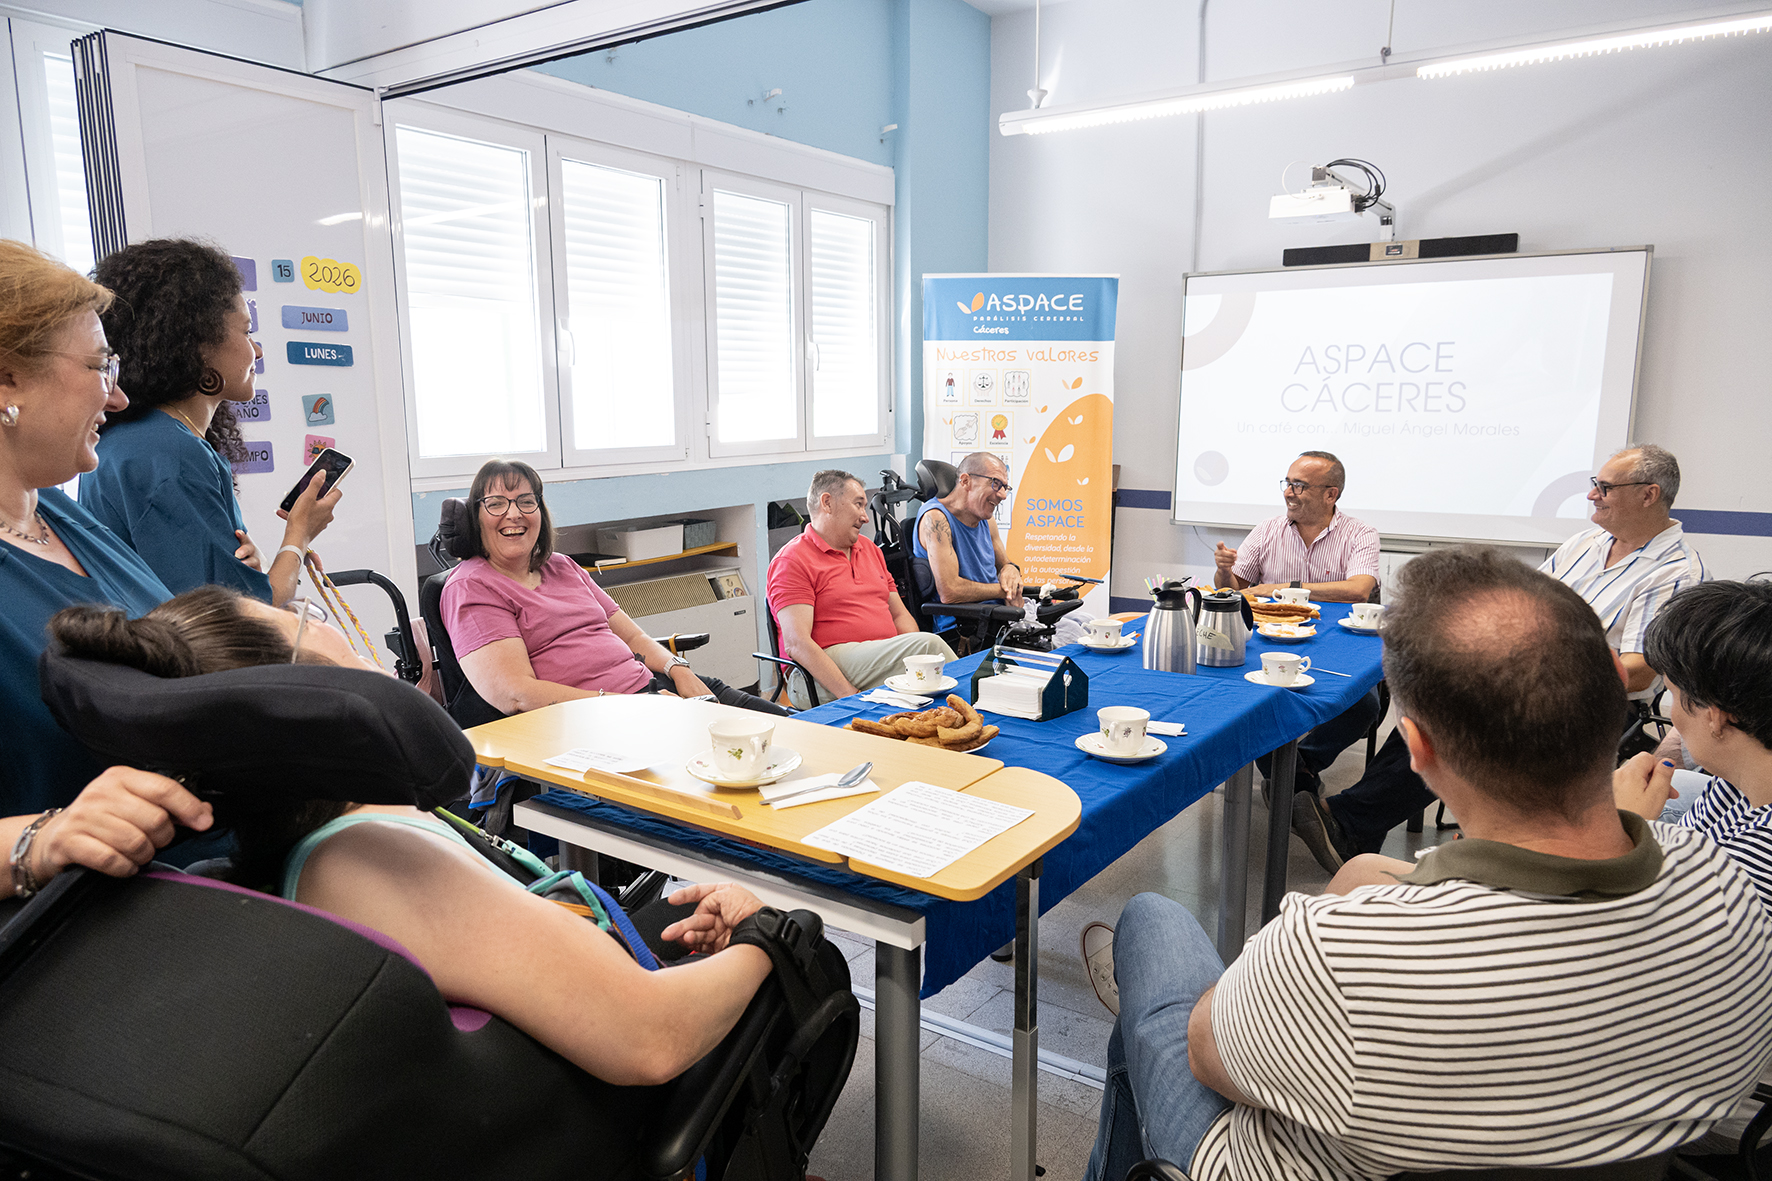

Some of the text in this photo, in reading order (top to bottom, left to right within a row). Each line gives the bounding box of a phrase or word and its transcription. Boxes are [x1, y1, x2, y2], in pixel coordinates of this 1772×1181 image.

[277, 264, 291, 278] 15
[309, 262, 355, 287] 2026
[986, 293, 1084, 314] ASPACE
[301, 311, 333, 325] JUNIO
[973, 325, 1010, 335] Cáceres
[304, 347, 337, 360] LUNES
[1293, 341, 1456, 375] ASPACE
[1280, 375, 1467, 413] CÁCERES
[1236, 421, 1254, 434] Un
[1259, 422, 1292, 434] café
[1343, 422, 1395, 437] Miguel
[1400, 420, 1448, 438] Ángel
[1453, 423, 1520, 436] Morales
[1026, 498, 1083, 512] SOMOS
[1025, 515, 1085, 528] ASPACE
[1024, 532, 1068, 542] Respetando
[1086, 545, 1094, 553] la
[1024, 555, 1092, 563] autodeterminación
[1030, 565, 1038, 573] la
[1038, 567, 1081, 575] autogestión
